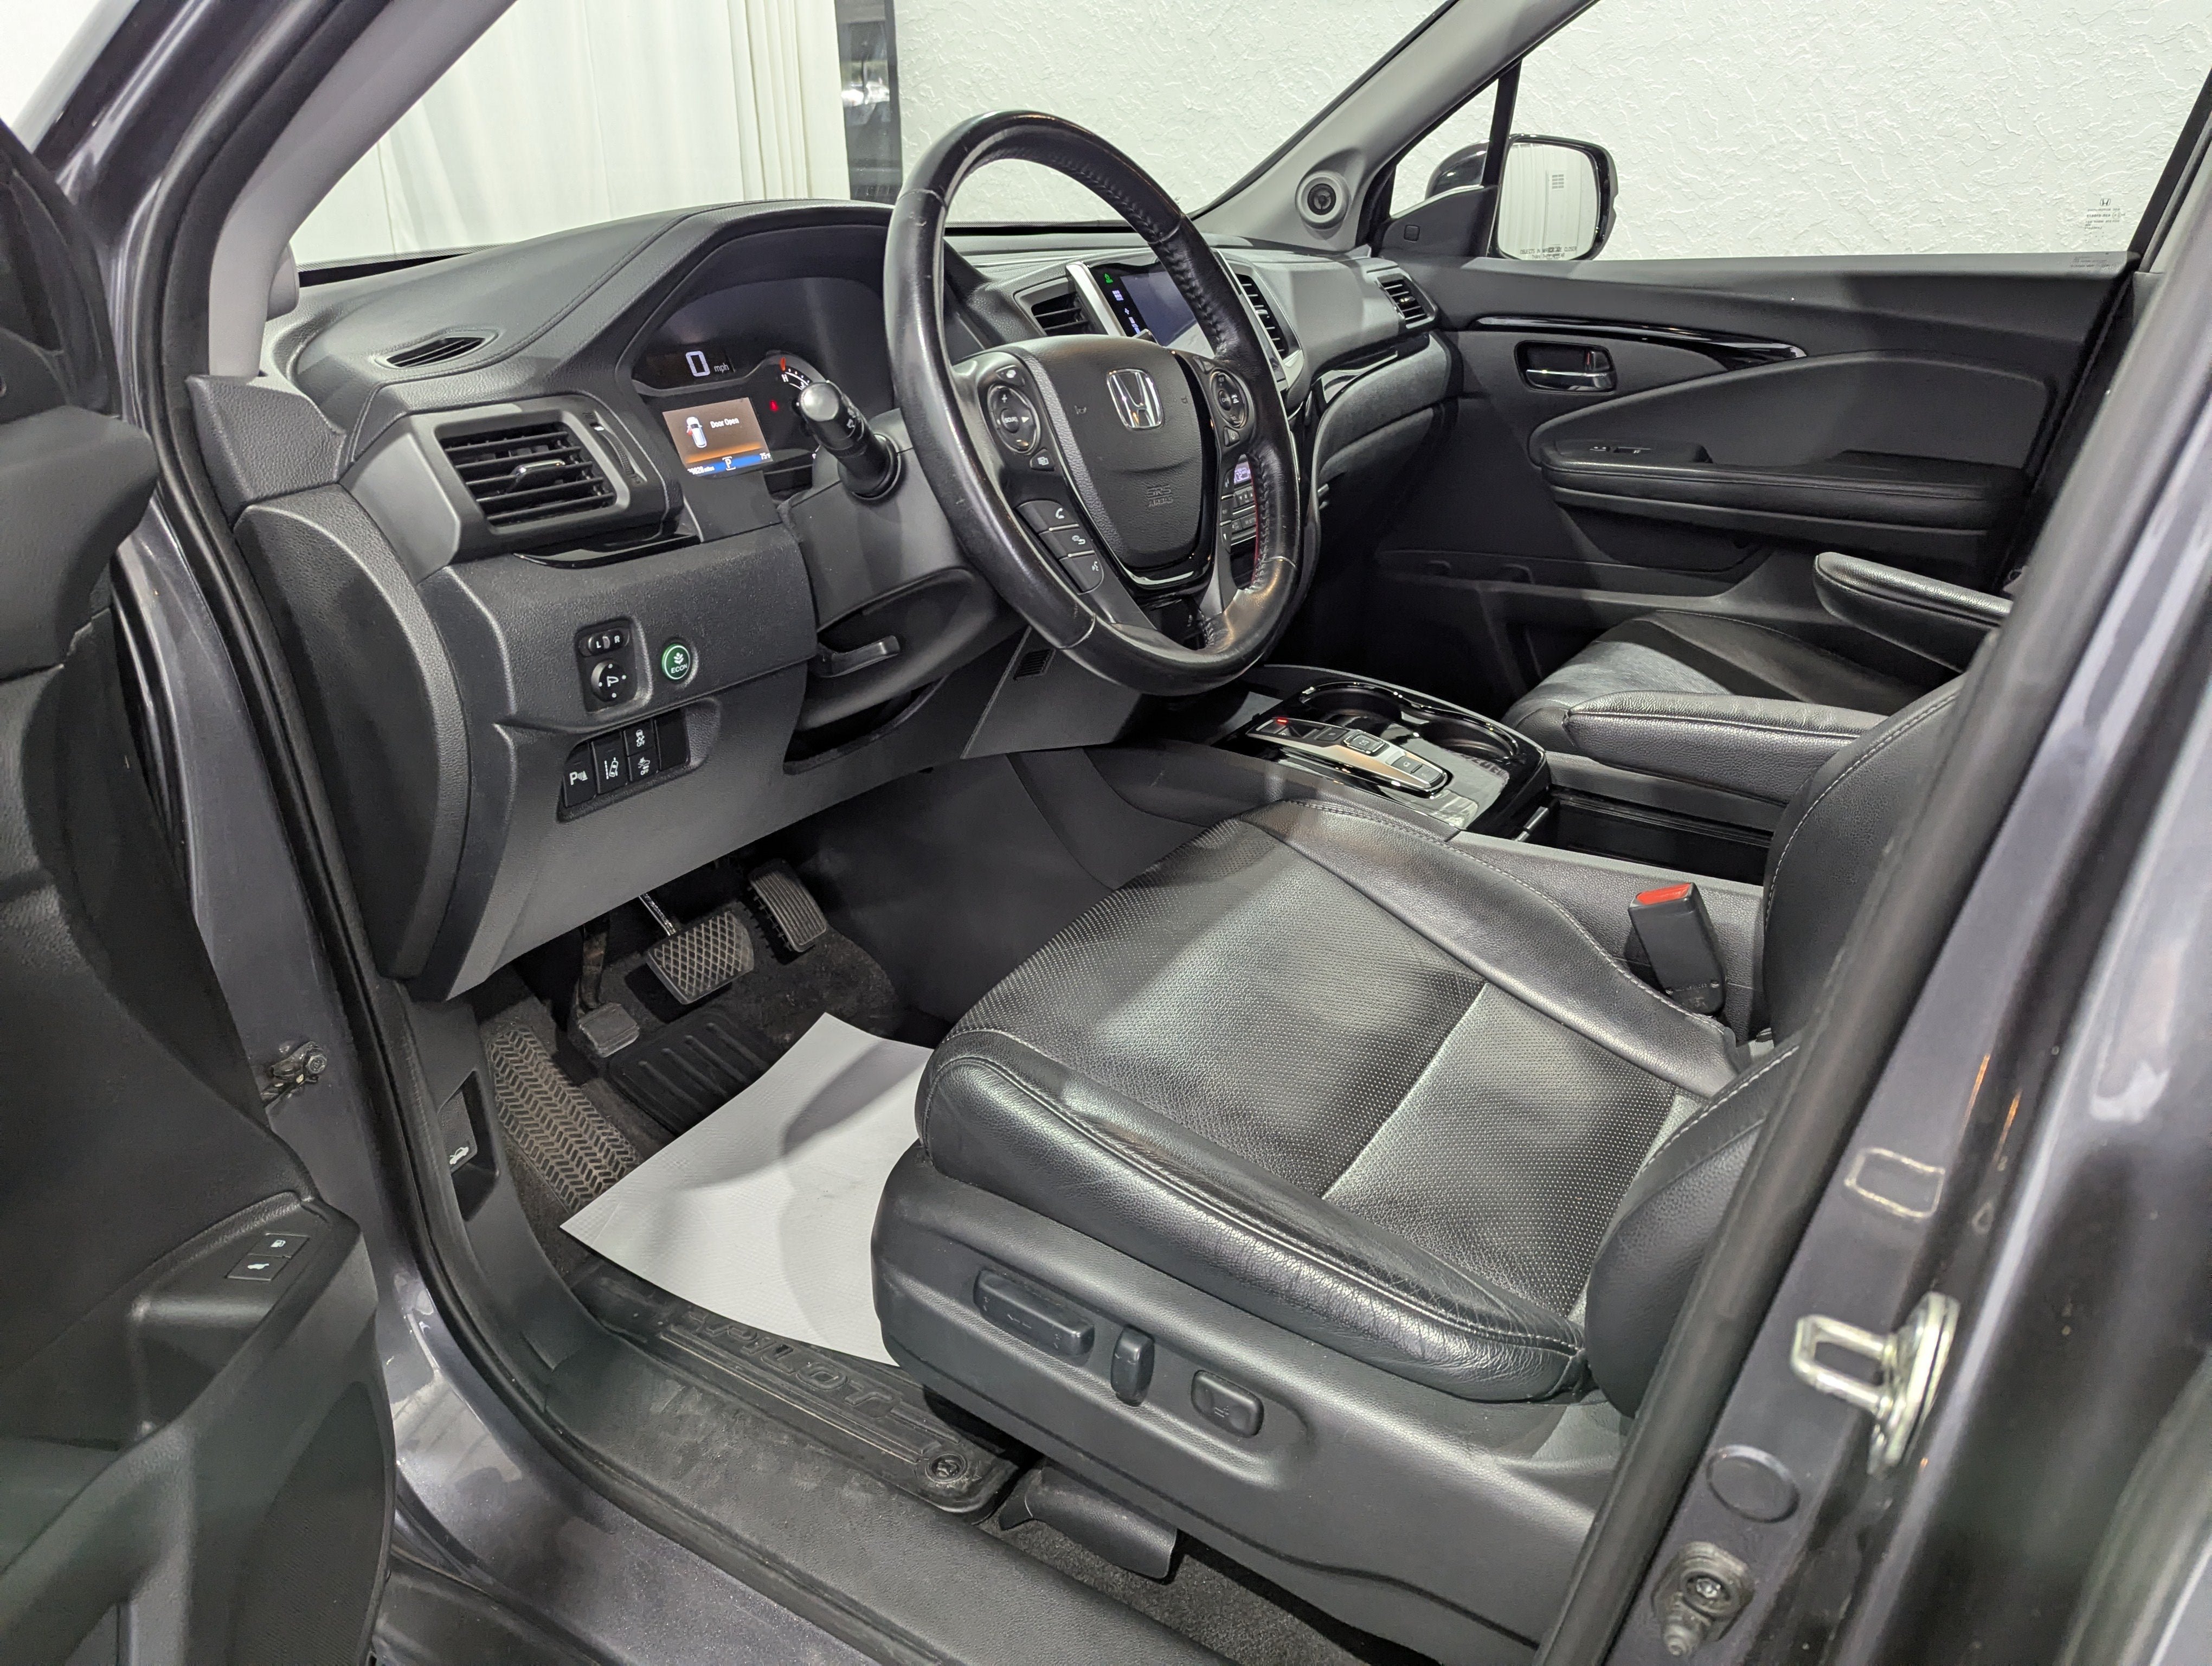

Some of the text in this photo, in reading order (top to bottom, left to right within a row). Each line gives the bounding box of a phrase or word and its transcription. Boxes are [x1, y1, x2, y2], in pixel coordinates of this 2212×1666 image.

[685, 350, 730, 377] 0 mph
[781, 373, 789, 382] H
[710, 418, 740, 428] Door Open
[724, 458, 732, 469] P
[671, 663, 688, 674] ECON
[570, 772, 577, 785] P
